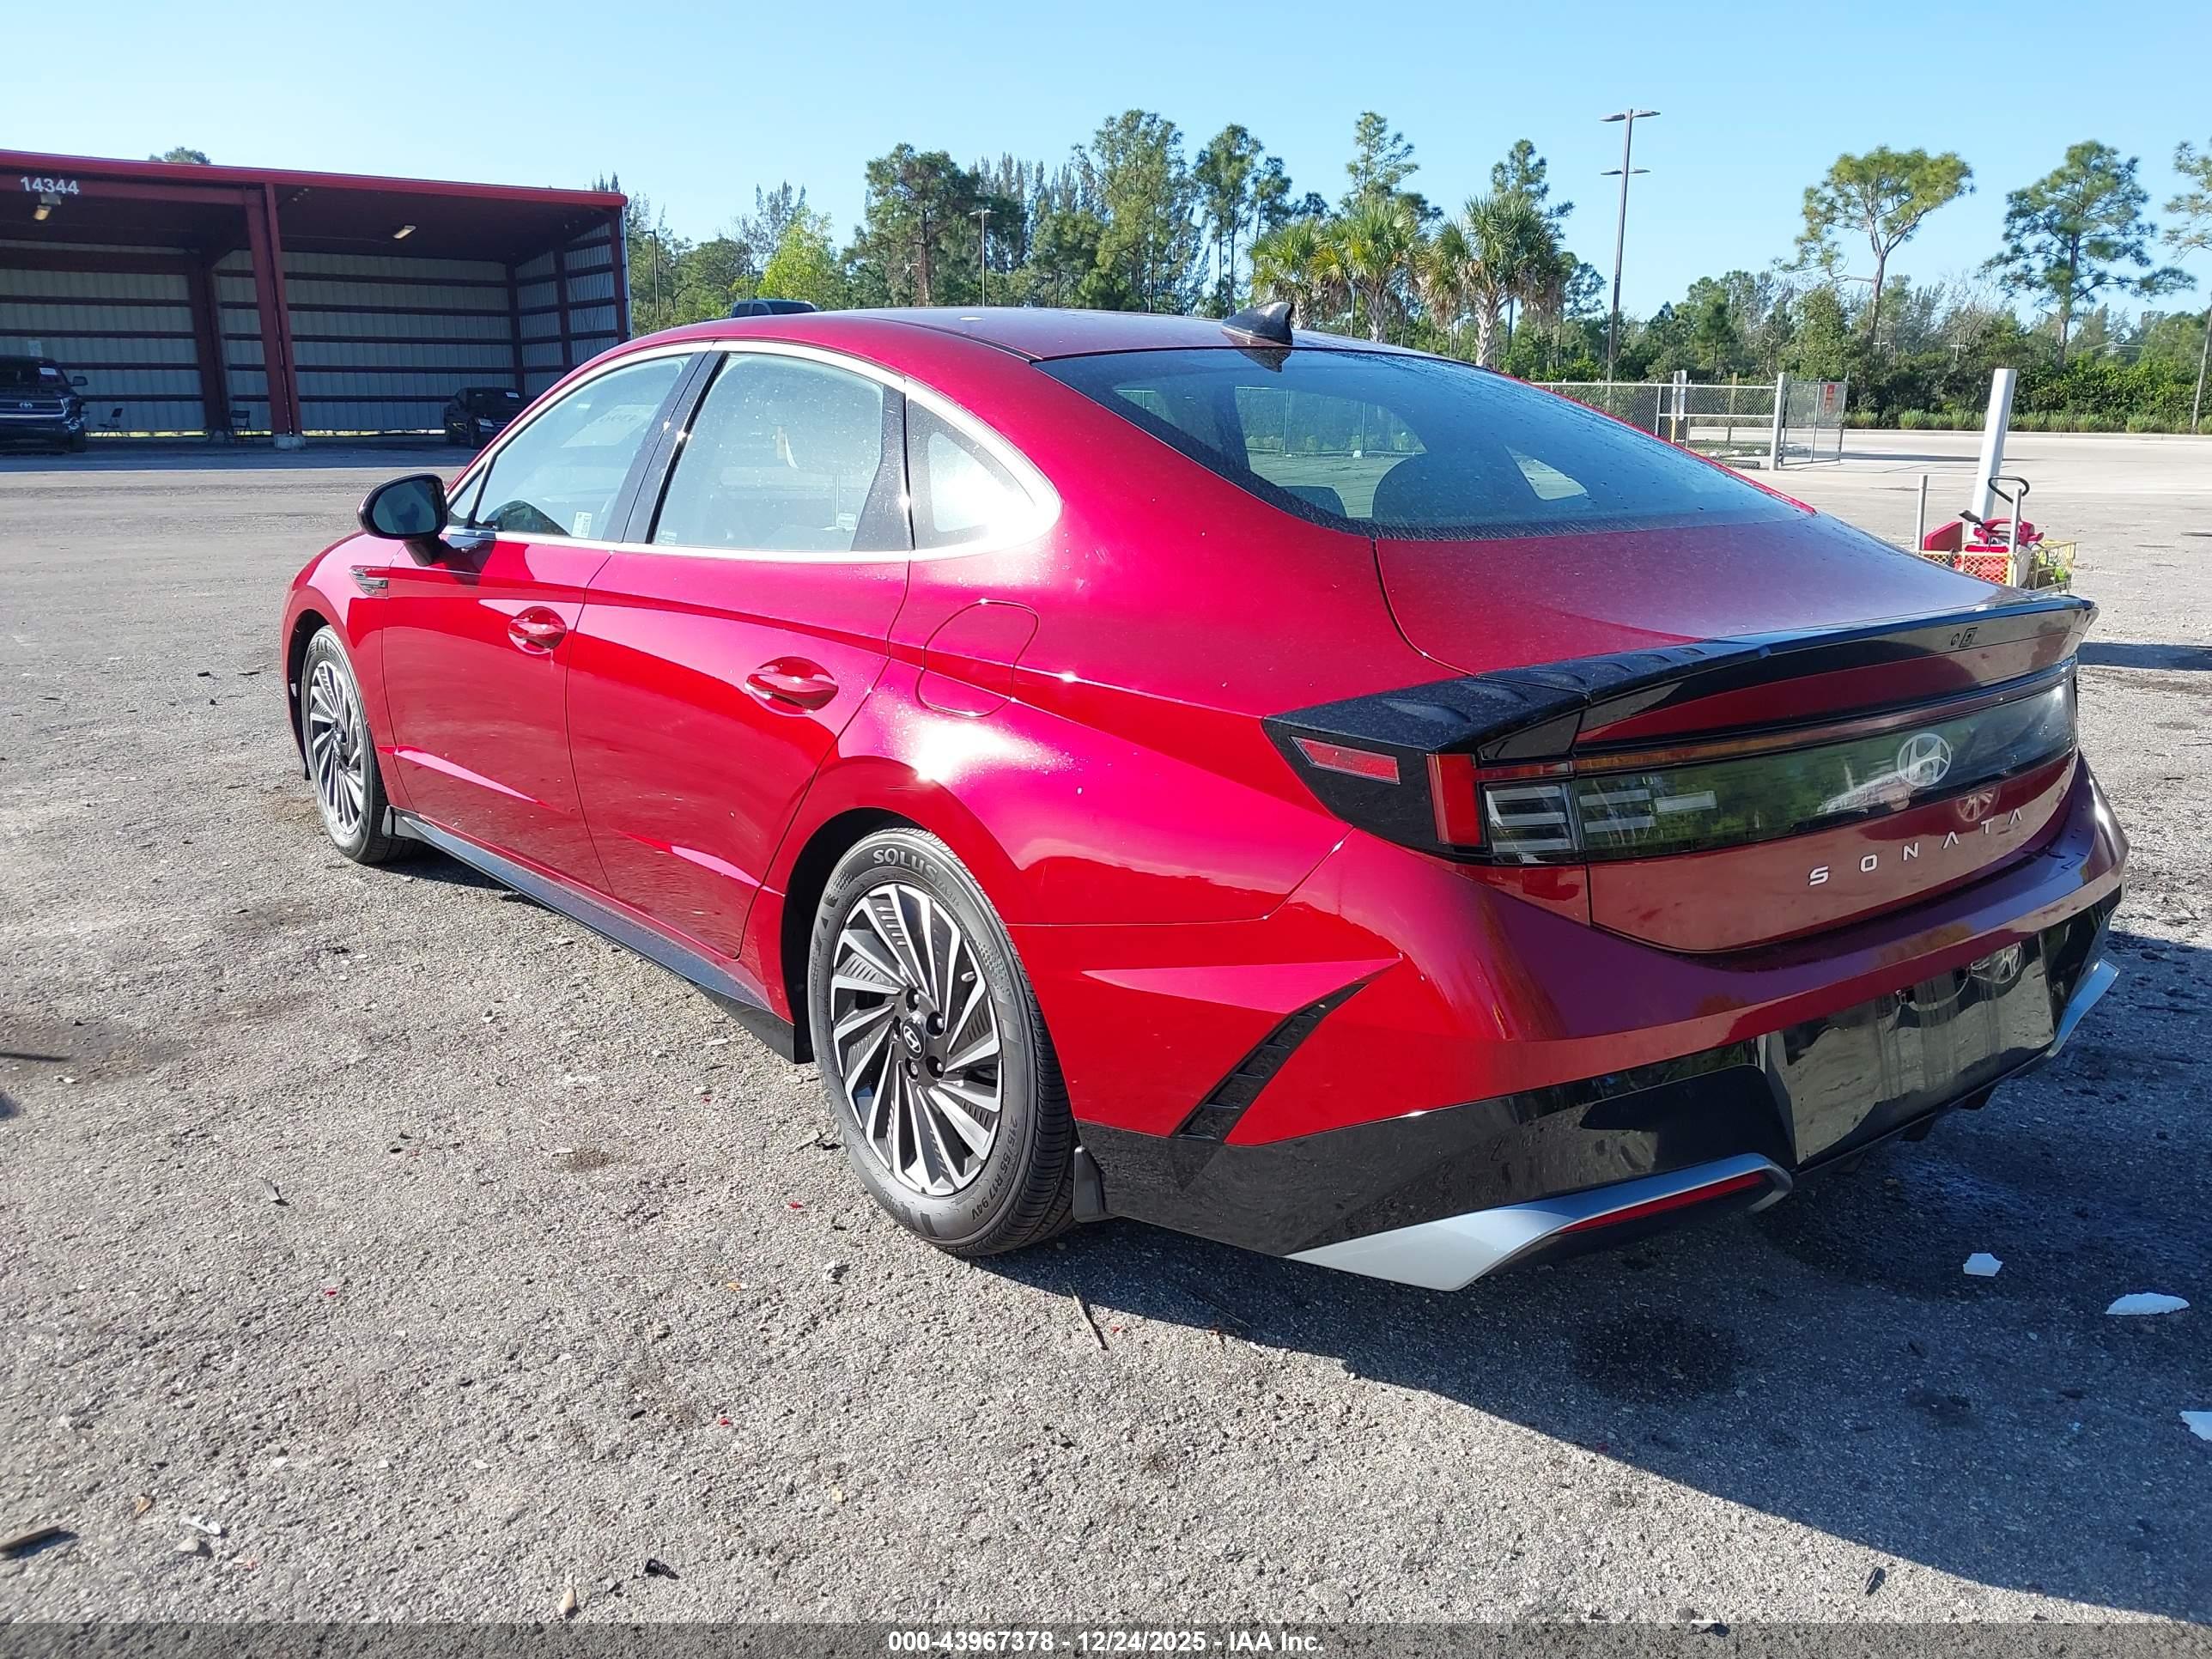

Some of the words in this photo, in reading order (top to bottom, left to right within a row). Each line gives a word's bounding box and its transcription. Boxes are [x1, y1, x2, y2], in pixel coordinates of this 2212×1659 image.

[21, 177, 80, 195] 14344
[1808, 808, 2022, 886] SONATA
[872, 848, 938, 881] SOLUS
[1000, 1115, 1018, 1174] 215/55
[988, 1173, 1004, 1200] R17
[971, 1197, 989, 1220] 94V
